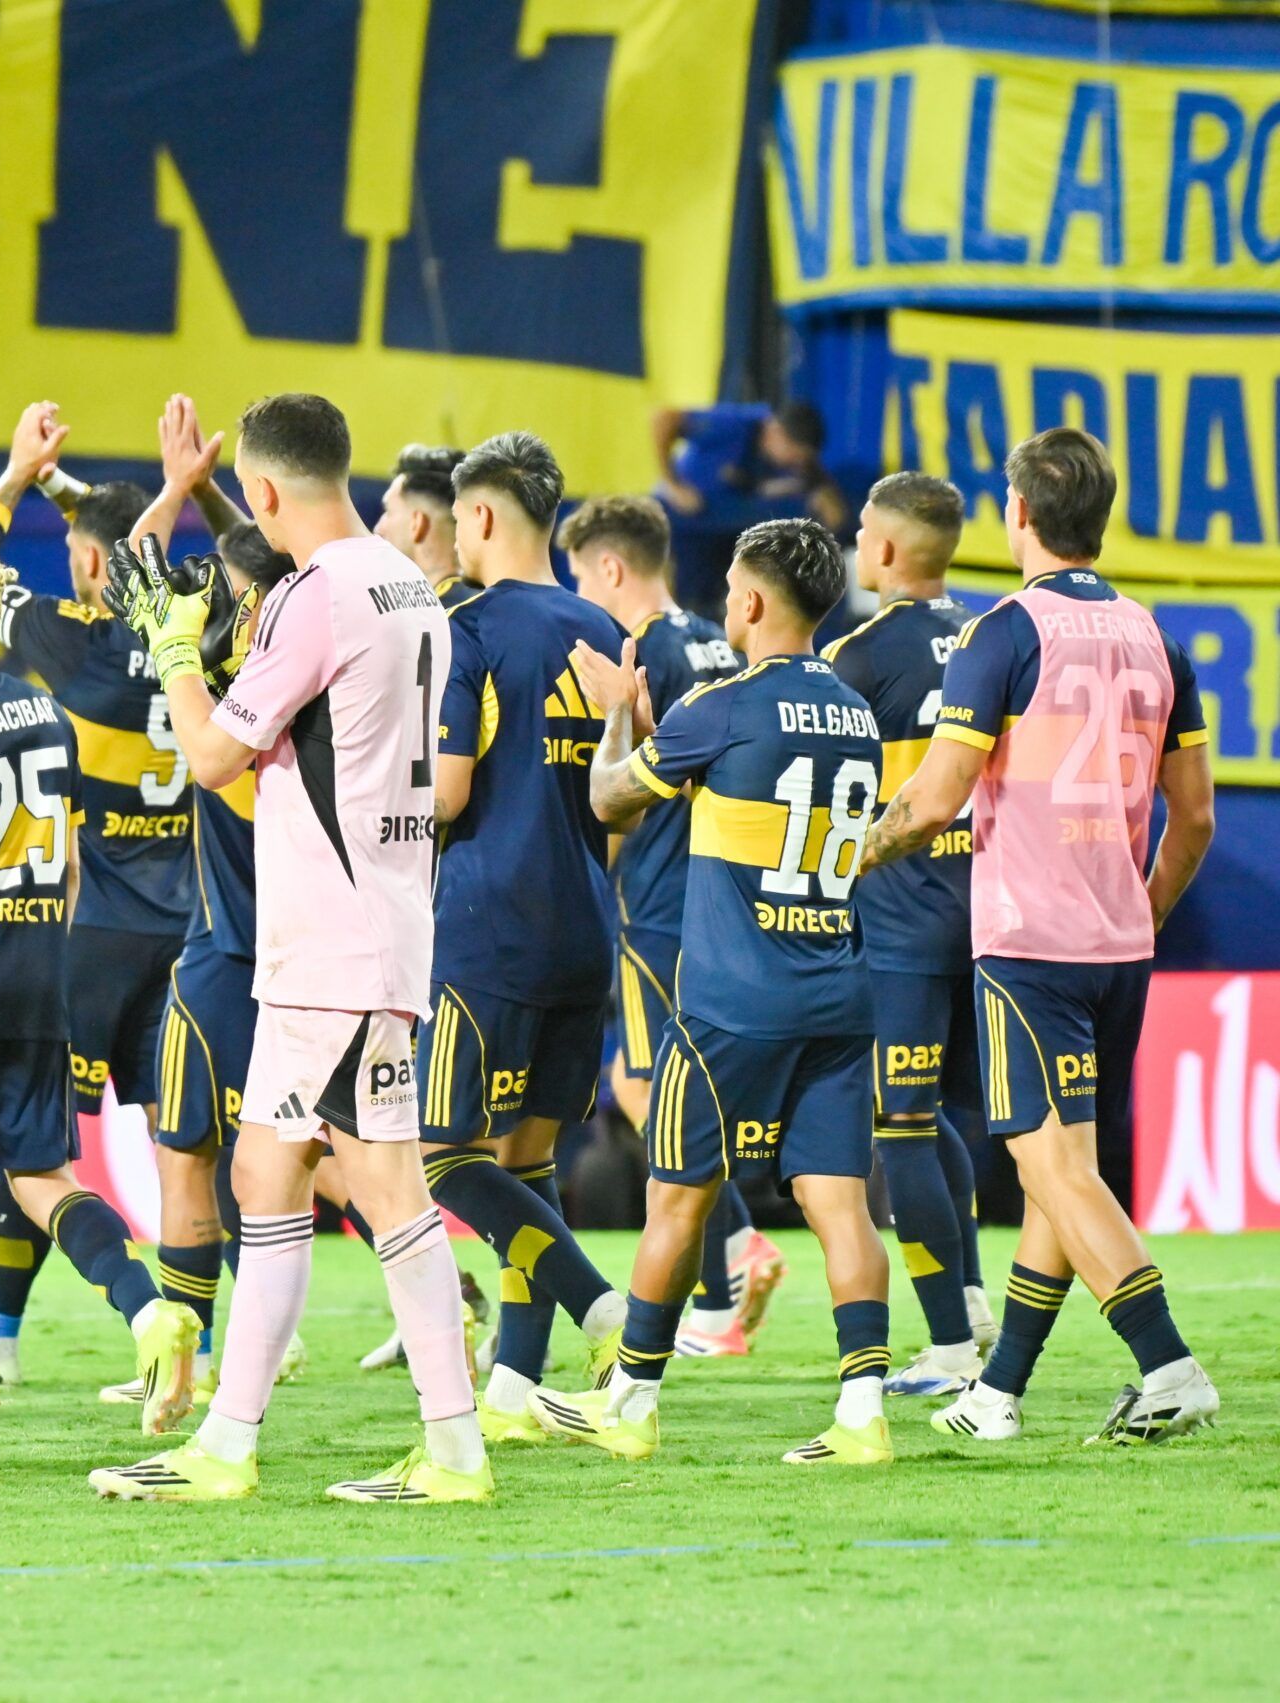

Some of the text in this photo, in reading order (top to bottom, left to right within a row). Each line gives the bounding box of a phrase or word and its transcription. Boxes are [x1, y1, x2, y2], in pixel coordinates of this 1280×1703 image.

[773, 71, 1123, 280] VILLA
[368, 579, 440, 616] MARCHES
[1069, 572, 1097, 585] 1905
[411, 631, 433, 787] 1
[776, 700, 880, 741] DELGADO
[140, 693, 189, 806] 5
[1051, 665, 1162, 808] 26
[761, 756, 878, 900] 18
[886, 1043, 942, 1076] pax
[1055, 1050, 1098, 1088] pa
[490, 1070, 527, 1102] pa
[735, 1120, 781, 1149] pa
[735, 1150, 775, 1159] assist
